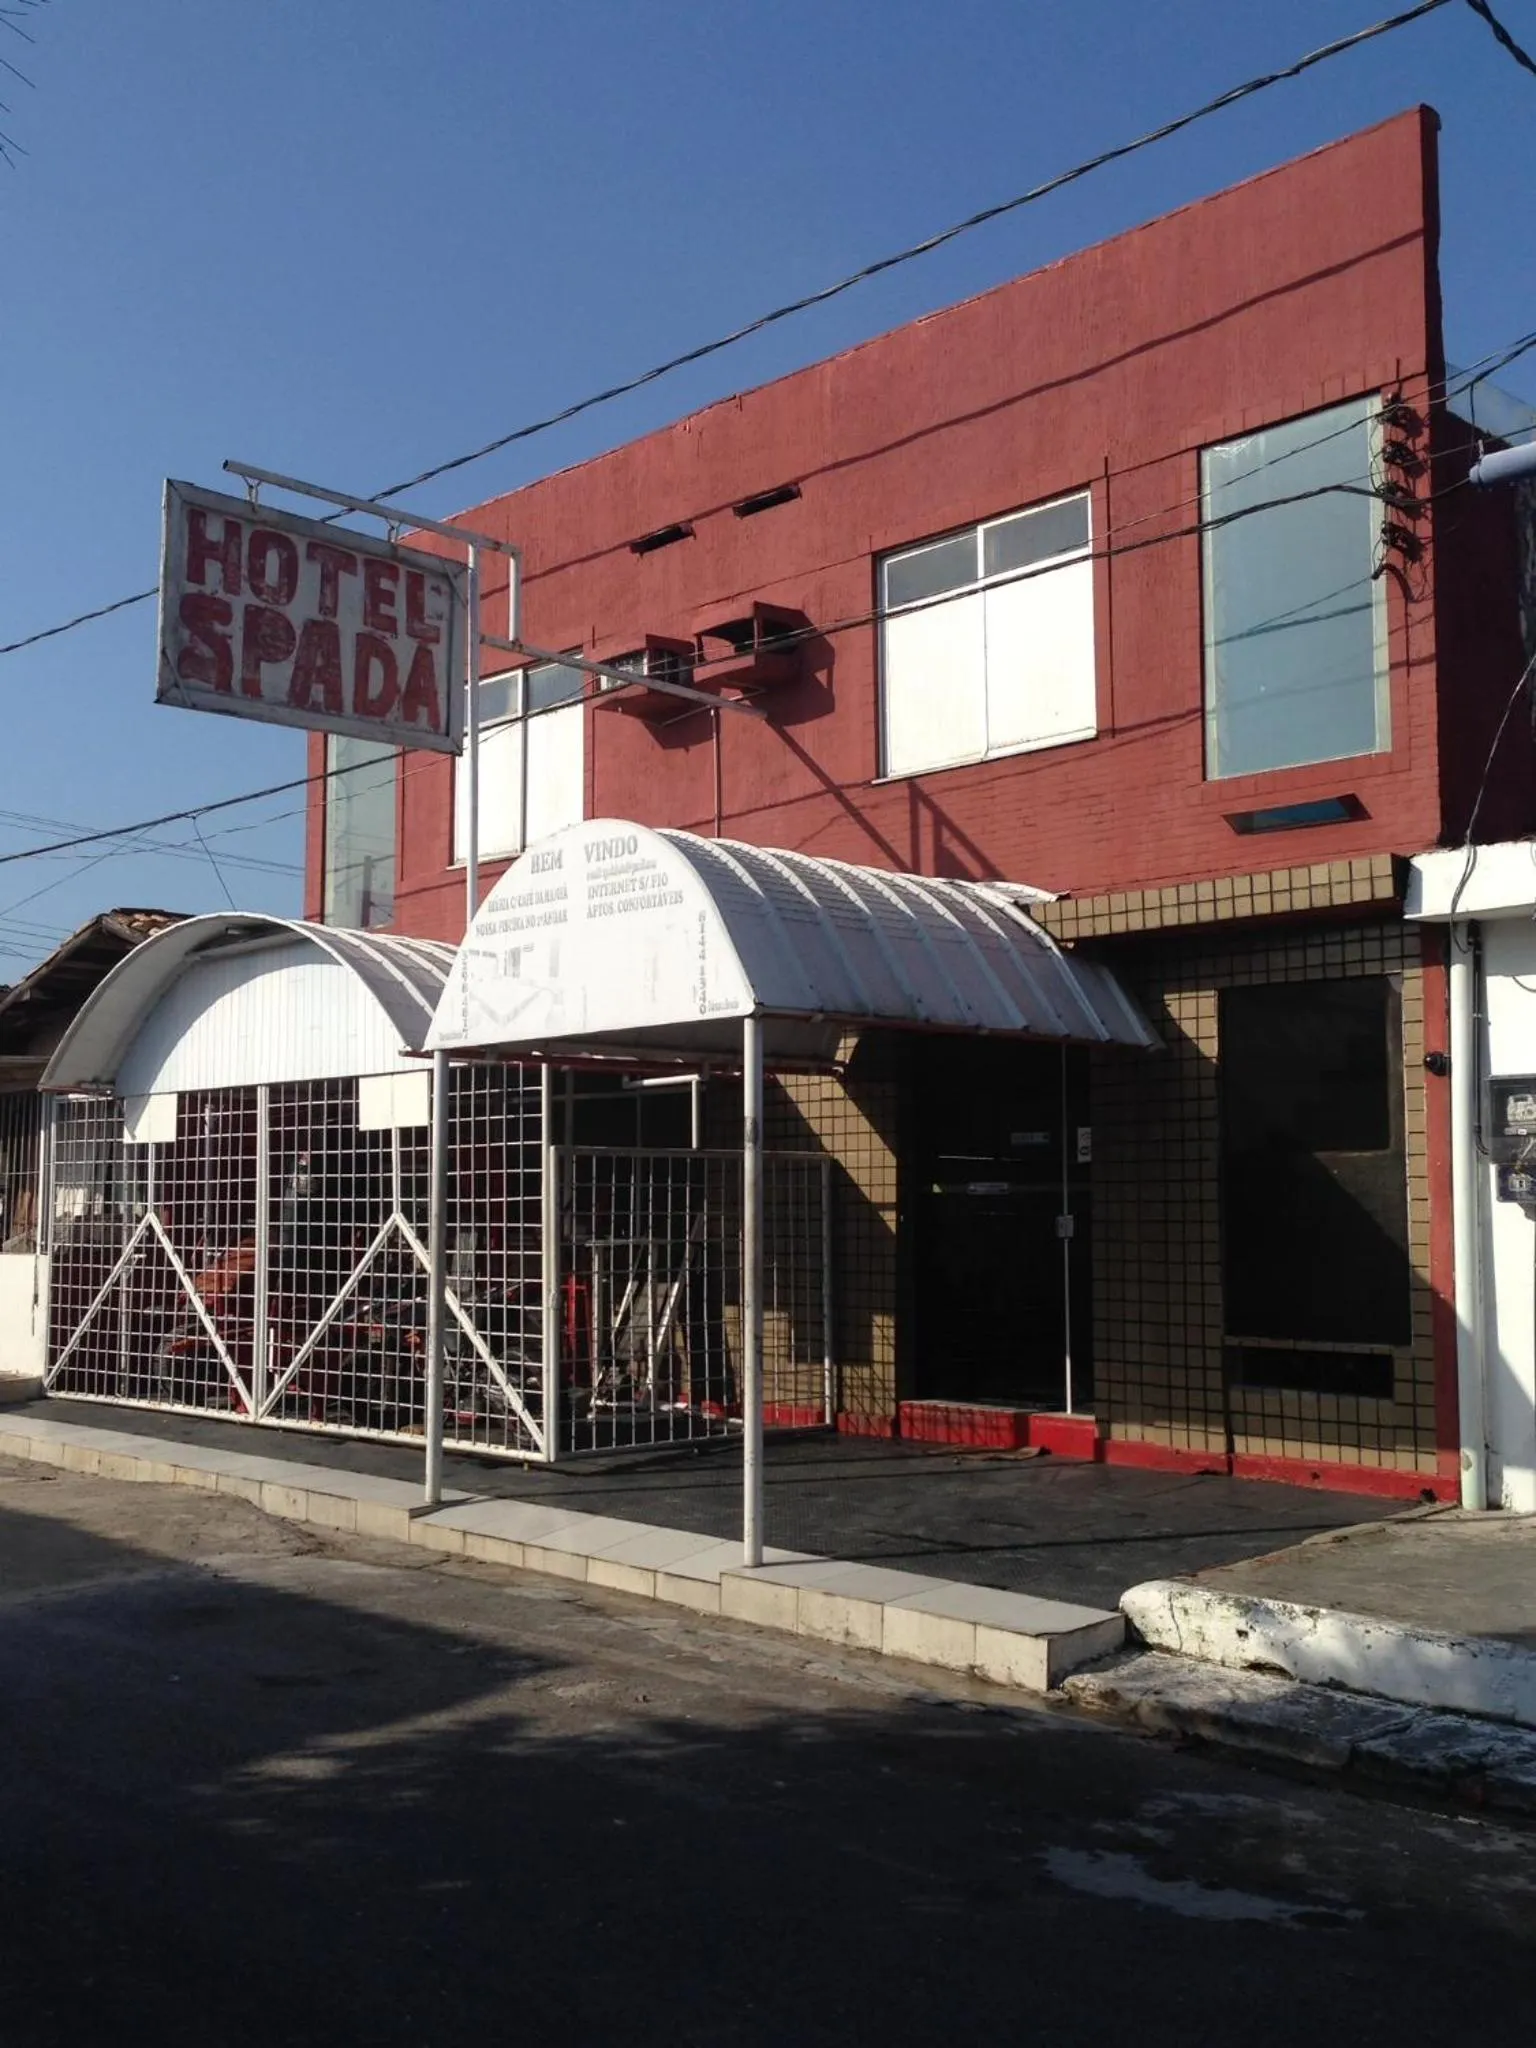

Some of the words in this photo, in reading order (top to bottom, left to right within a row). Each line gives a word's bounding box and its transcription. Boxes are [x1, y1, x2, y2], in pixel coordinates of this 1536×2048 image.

[186, 508, 441, 645] HOTEL
[178, 592, 441, 733] SPADA
[531, 850, 563, 874] BEM
[584, 835, 638, 863] VINDO
[588, 878, 637, 900] INTERNET
